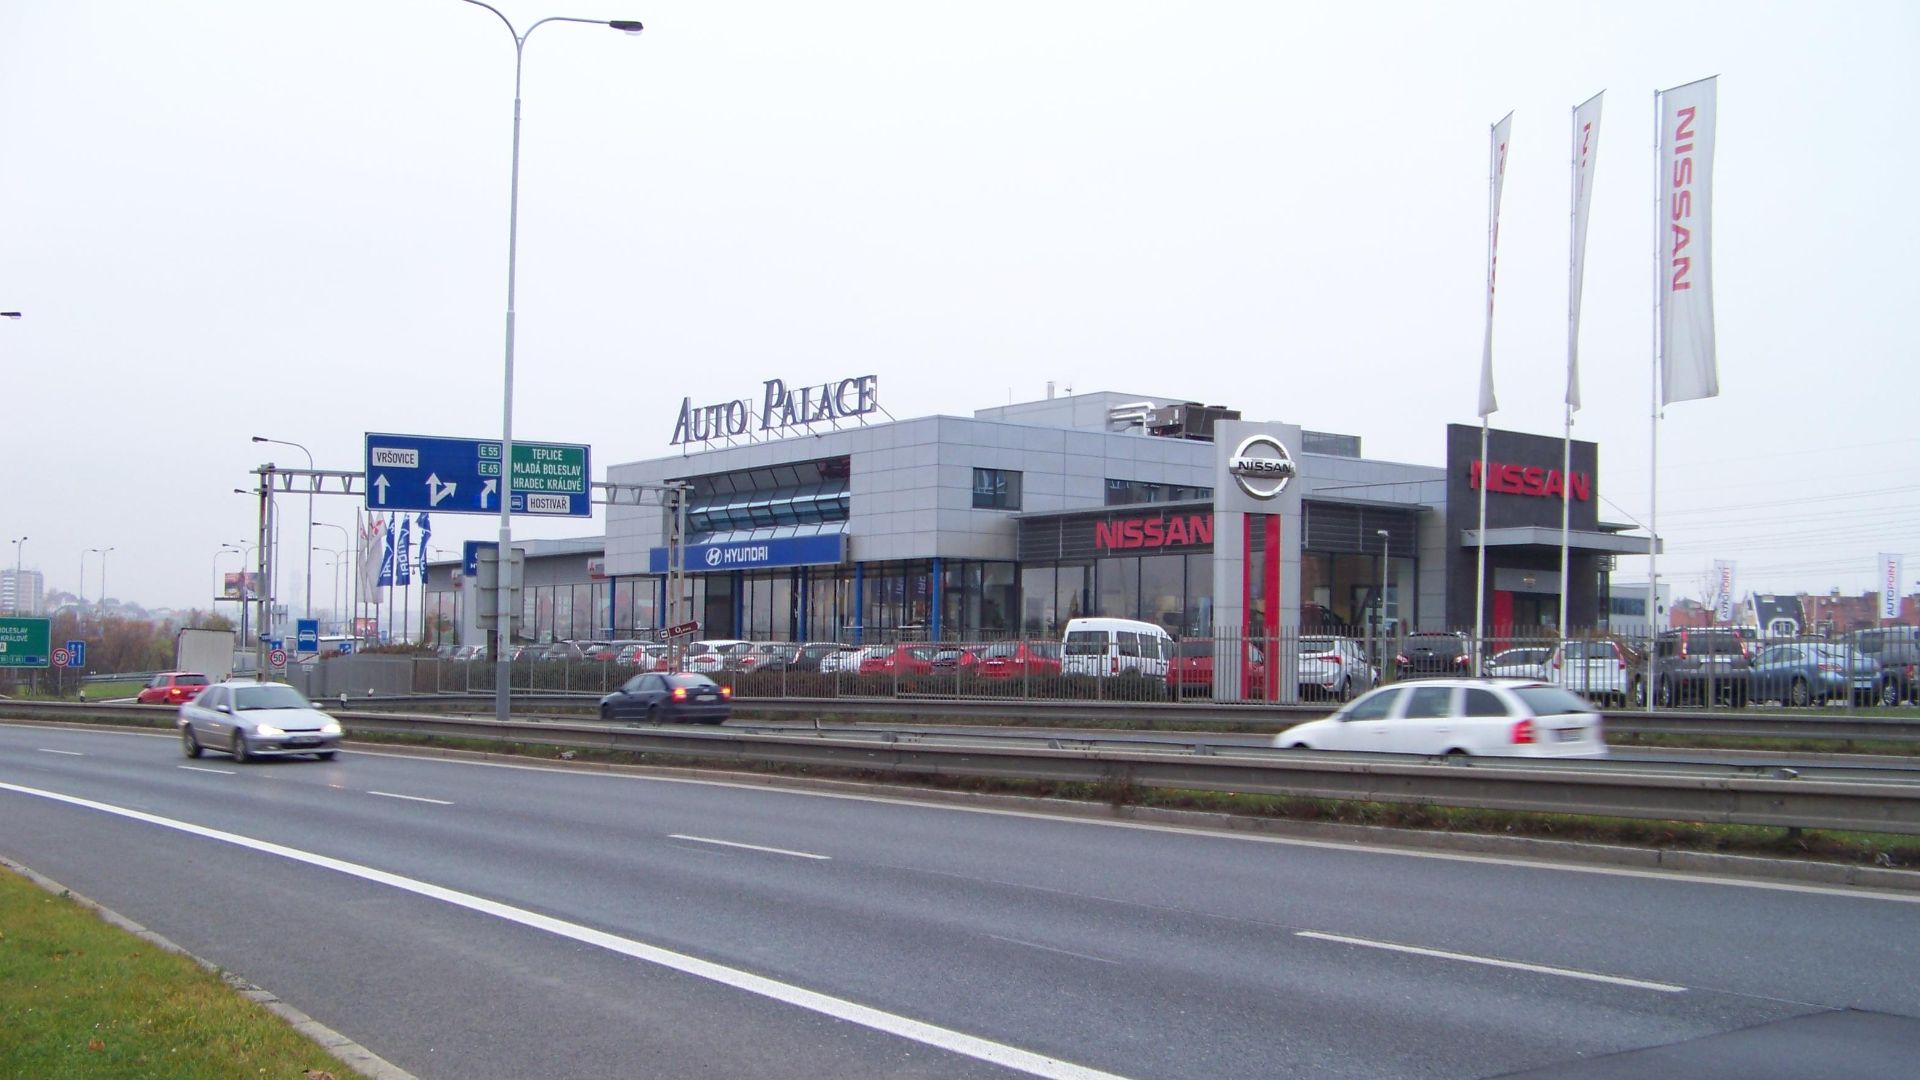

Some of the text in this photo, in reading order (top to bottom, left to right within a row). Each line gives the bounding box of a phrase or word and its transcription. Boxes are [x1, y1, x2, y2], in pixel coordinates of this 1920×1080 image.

[1671, 105, 1696, 292] NISSAN
[669, 374, 878, 445] AUTO PALACE
[376, 450, 415, 465] VRŠOVICE
[480, 447, 498, 457] E 55
[532, 448, 563, 461] TEPLICE
[480, 464, 498, 474] E 65
[513, 461, 581, 477] MLADÁ BOLESLAV
[1238, 460, 1292, 474] NISSAN
[513, 477, 582, 491] HRADEC KRÁLOVÉ
[1471, 459, 1590, 502] NISSAN
[530, 496, 567, 510] HOSTIVAŘ
[1096, 514, 1214, 550] NISSAN
[724, 545, 769, 563] HYUNDAI
[1887, 560, 1896, 616] AUTOPOINT
[55, 653, 66, 662] 50
[273, 654, 282, 662] 50
